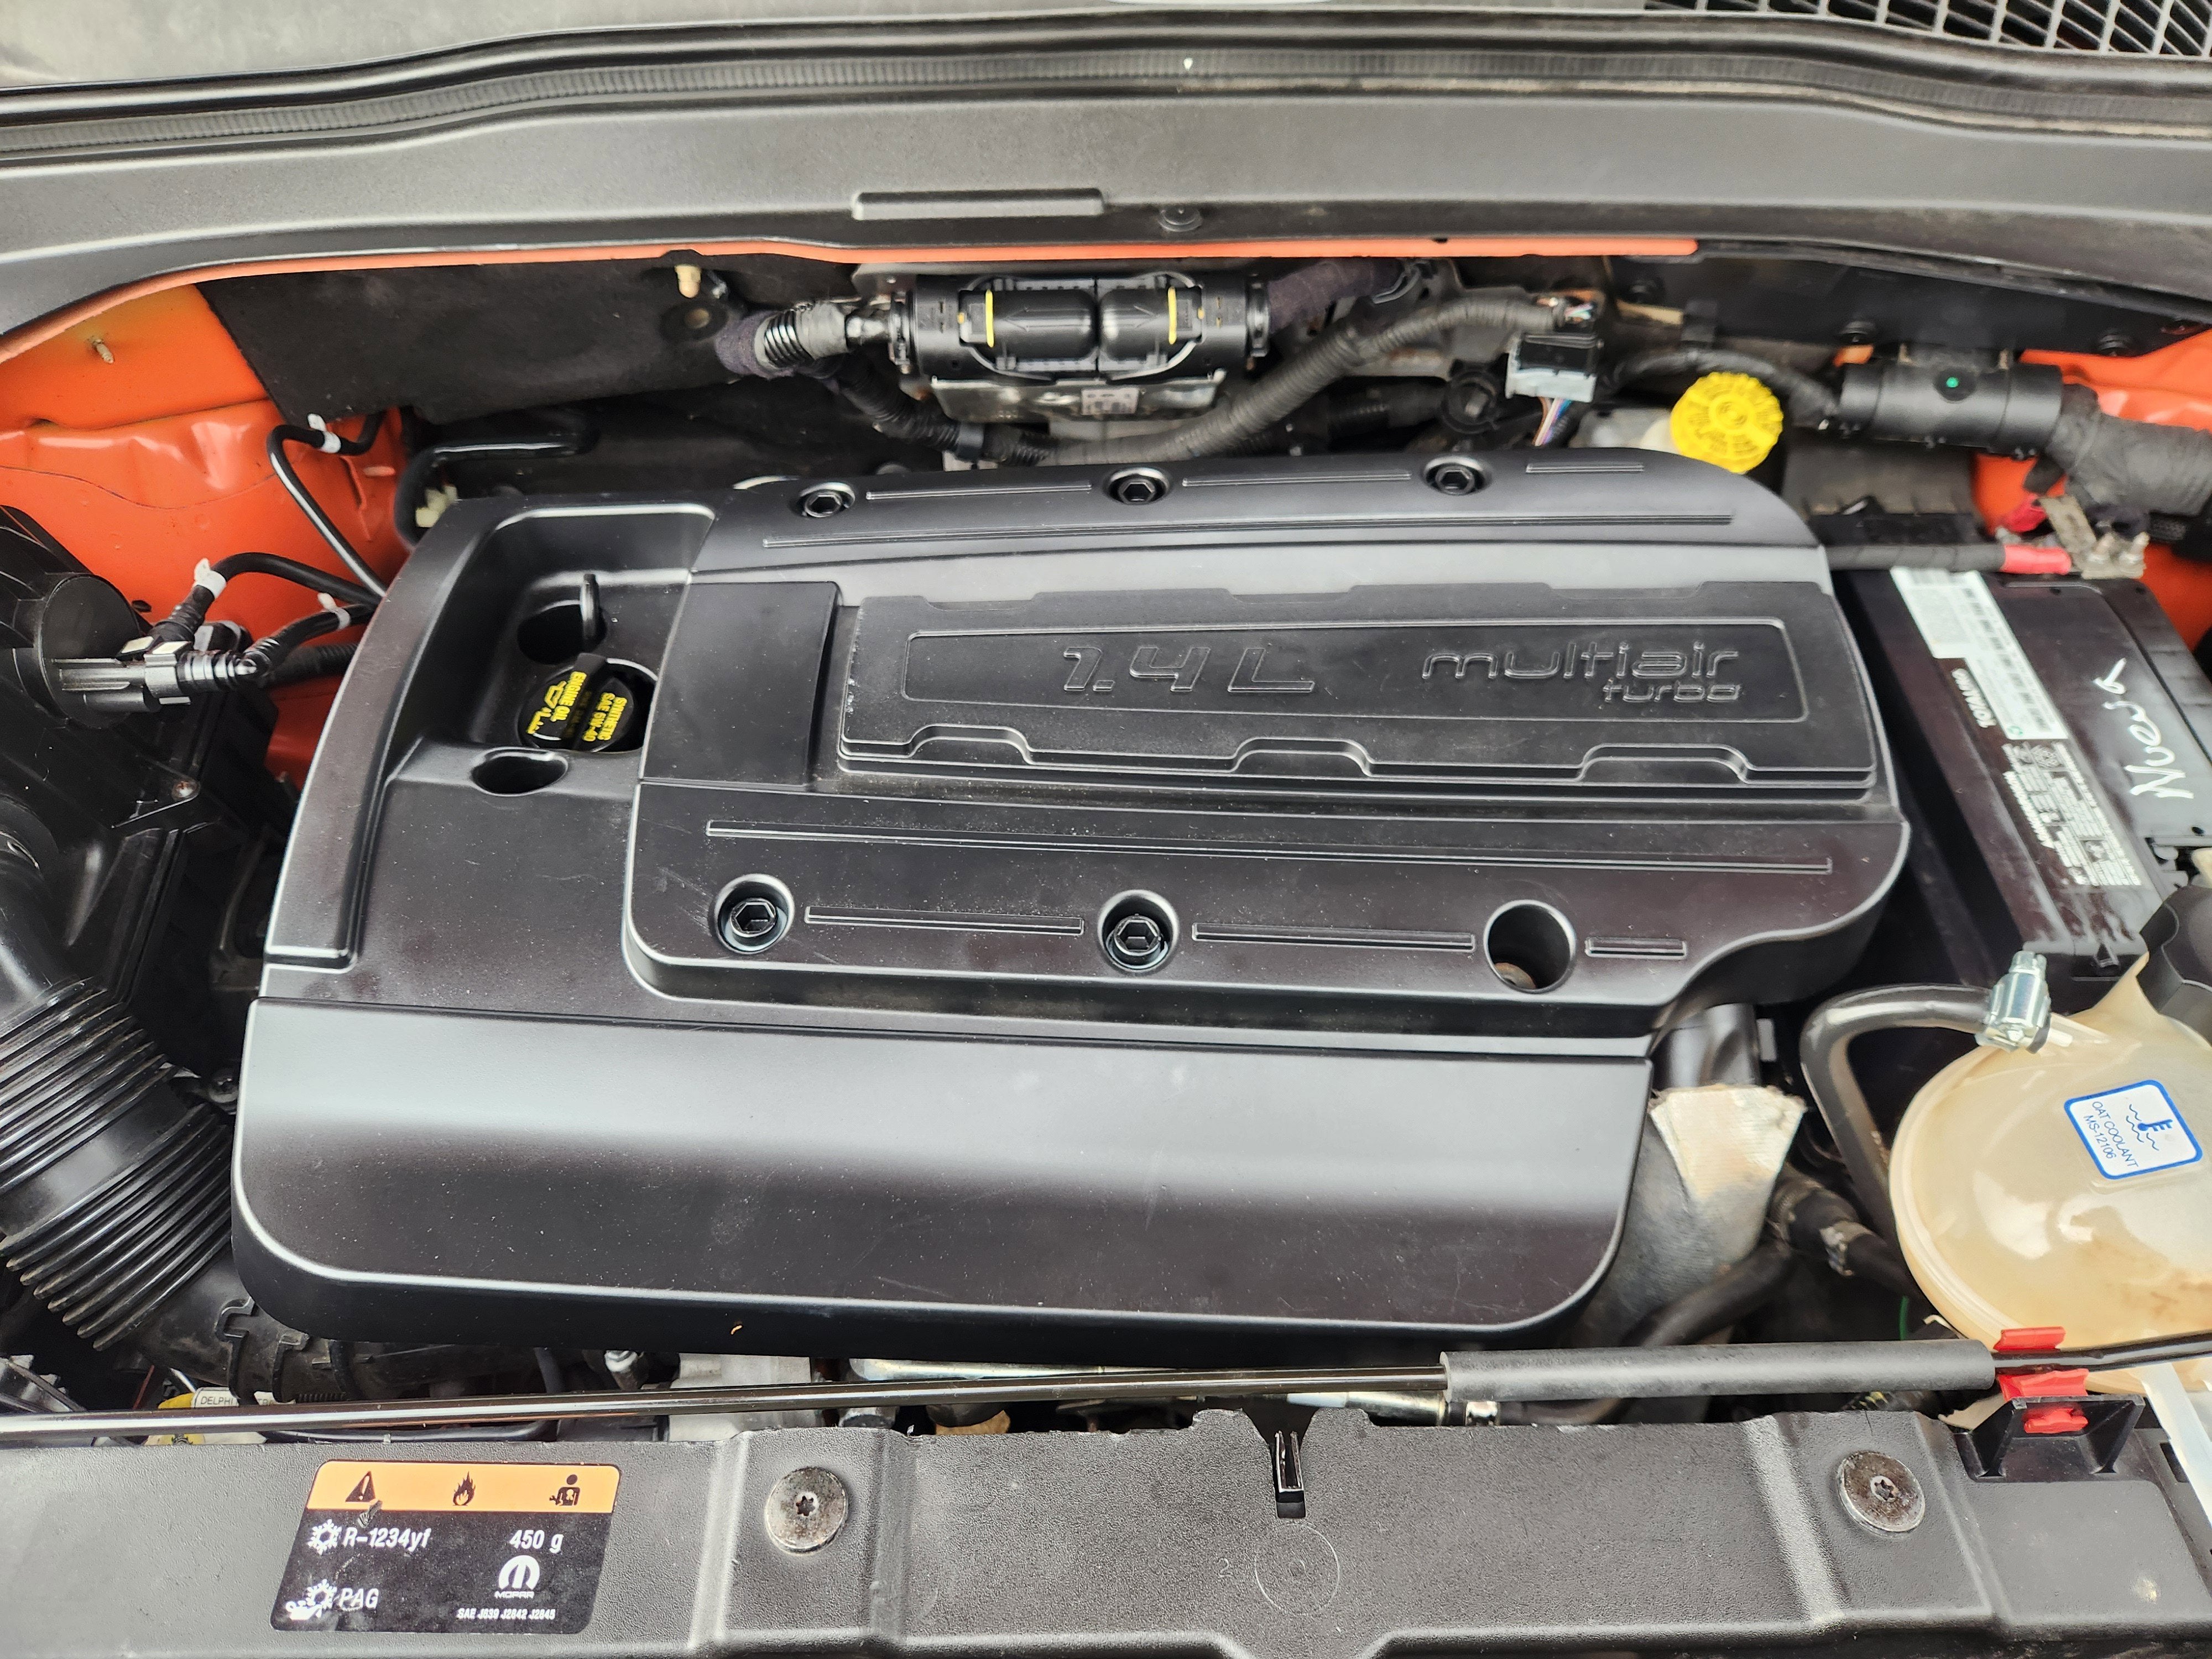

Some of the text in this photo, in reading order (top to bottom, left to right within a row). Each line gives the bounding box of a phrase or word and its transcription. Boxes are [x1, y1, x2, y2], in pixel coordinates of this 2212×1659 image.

[1422, 640, 1739, 680] multiair
[550, 671, 587, 722] ENGINE OIL
[1603, 678, 1741, 703] turbo
[2083, 1115, 2116, 1159] MS-12106
[2092, 1101, 2138, 1167] OAT COOLANT
[200, 1396, 233, 1405] DELPHI
[342, 1527, 564, 1553] R-1234yf 450 g
[338, 1588, 379, 1609] PAG
[494, 1590, 535, 1599] MOPAR
[456, 1608, 477, 1620] SAE
[500, 1608, 528, 1620] J2842
